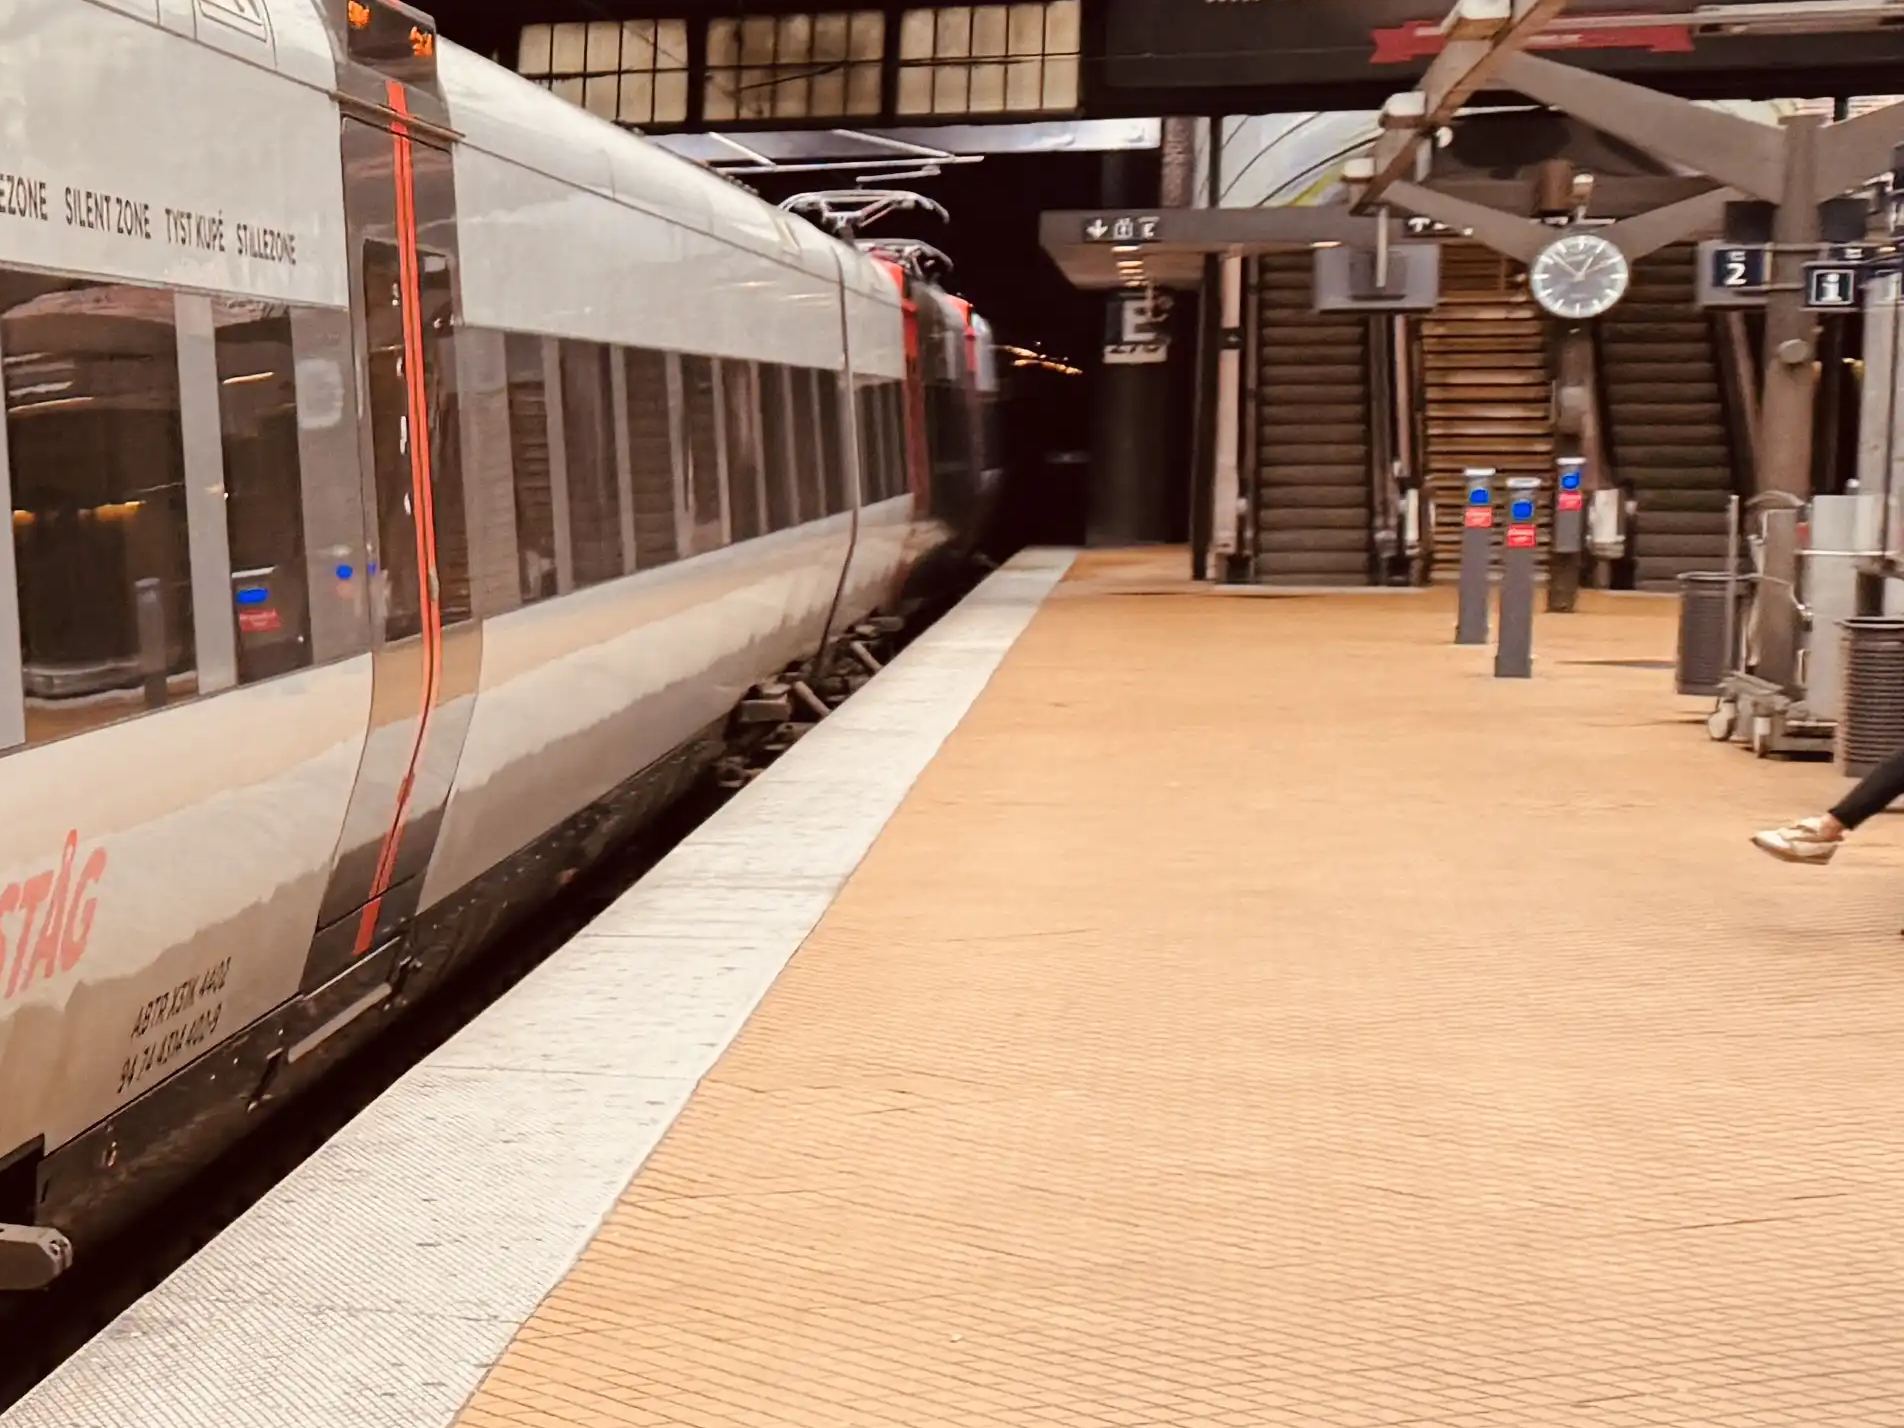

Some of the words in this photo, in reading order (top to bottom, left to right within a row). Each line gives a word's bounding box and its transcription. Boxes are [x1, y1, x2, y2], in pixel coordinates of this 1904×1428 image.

[65, 186, 111, 232] SILENT
[116, 197, 152, 240] ZONE
[164, 207, 193, 245] TYST
[195, 209, 226, 252] KUPÉ
[236, 222, 297, 265] STILLEZONE
[1724, 263, 1747, 285] 2
